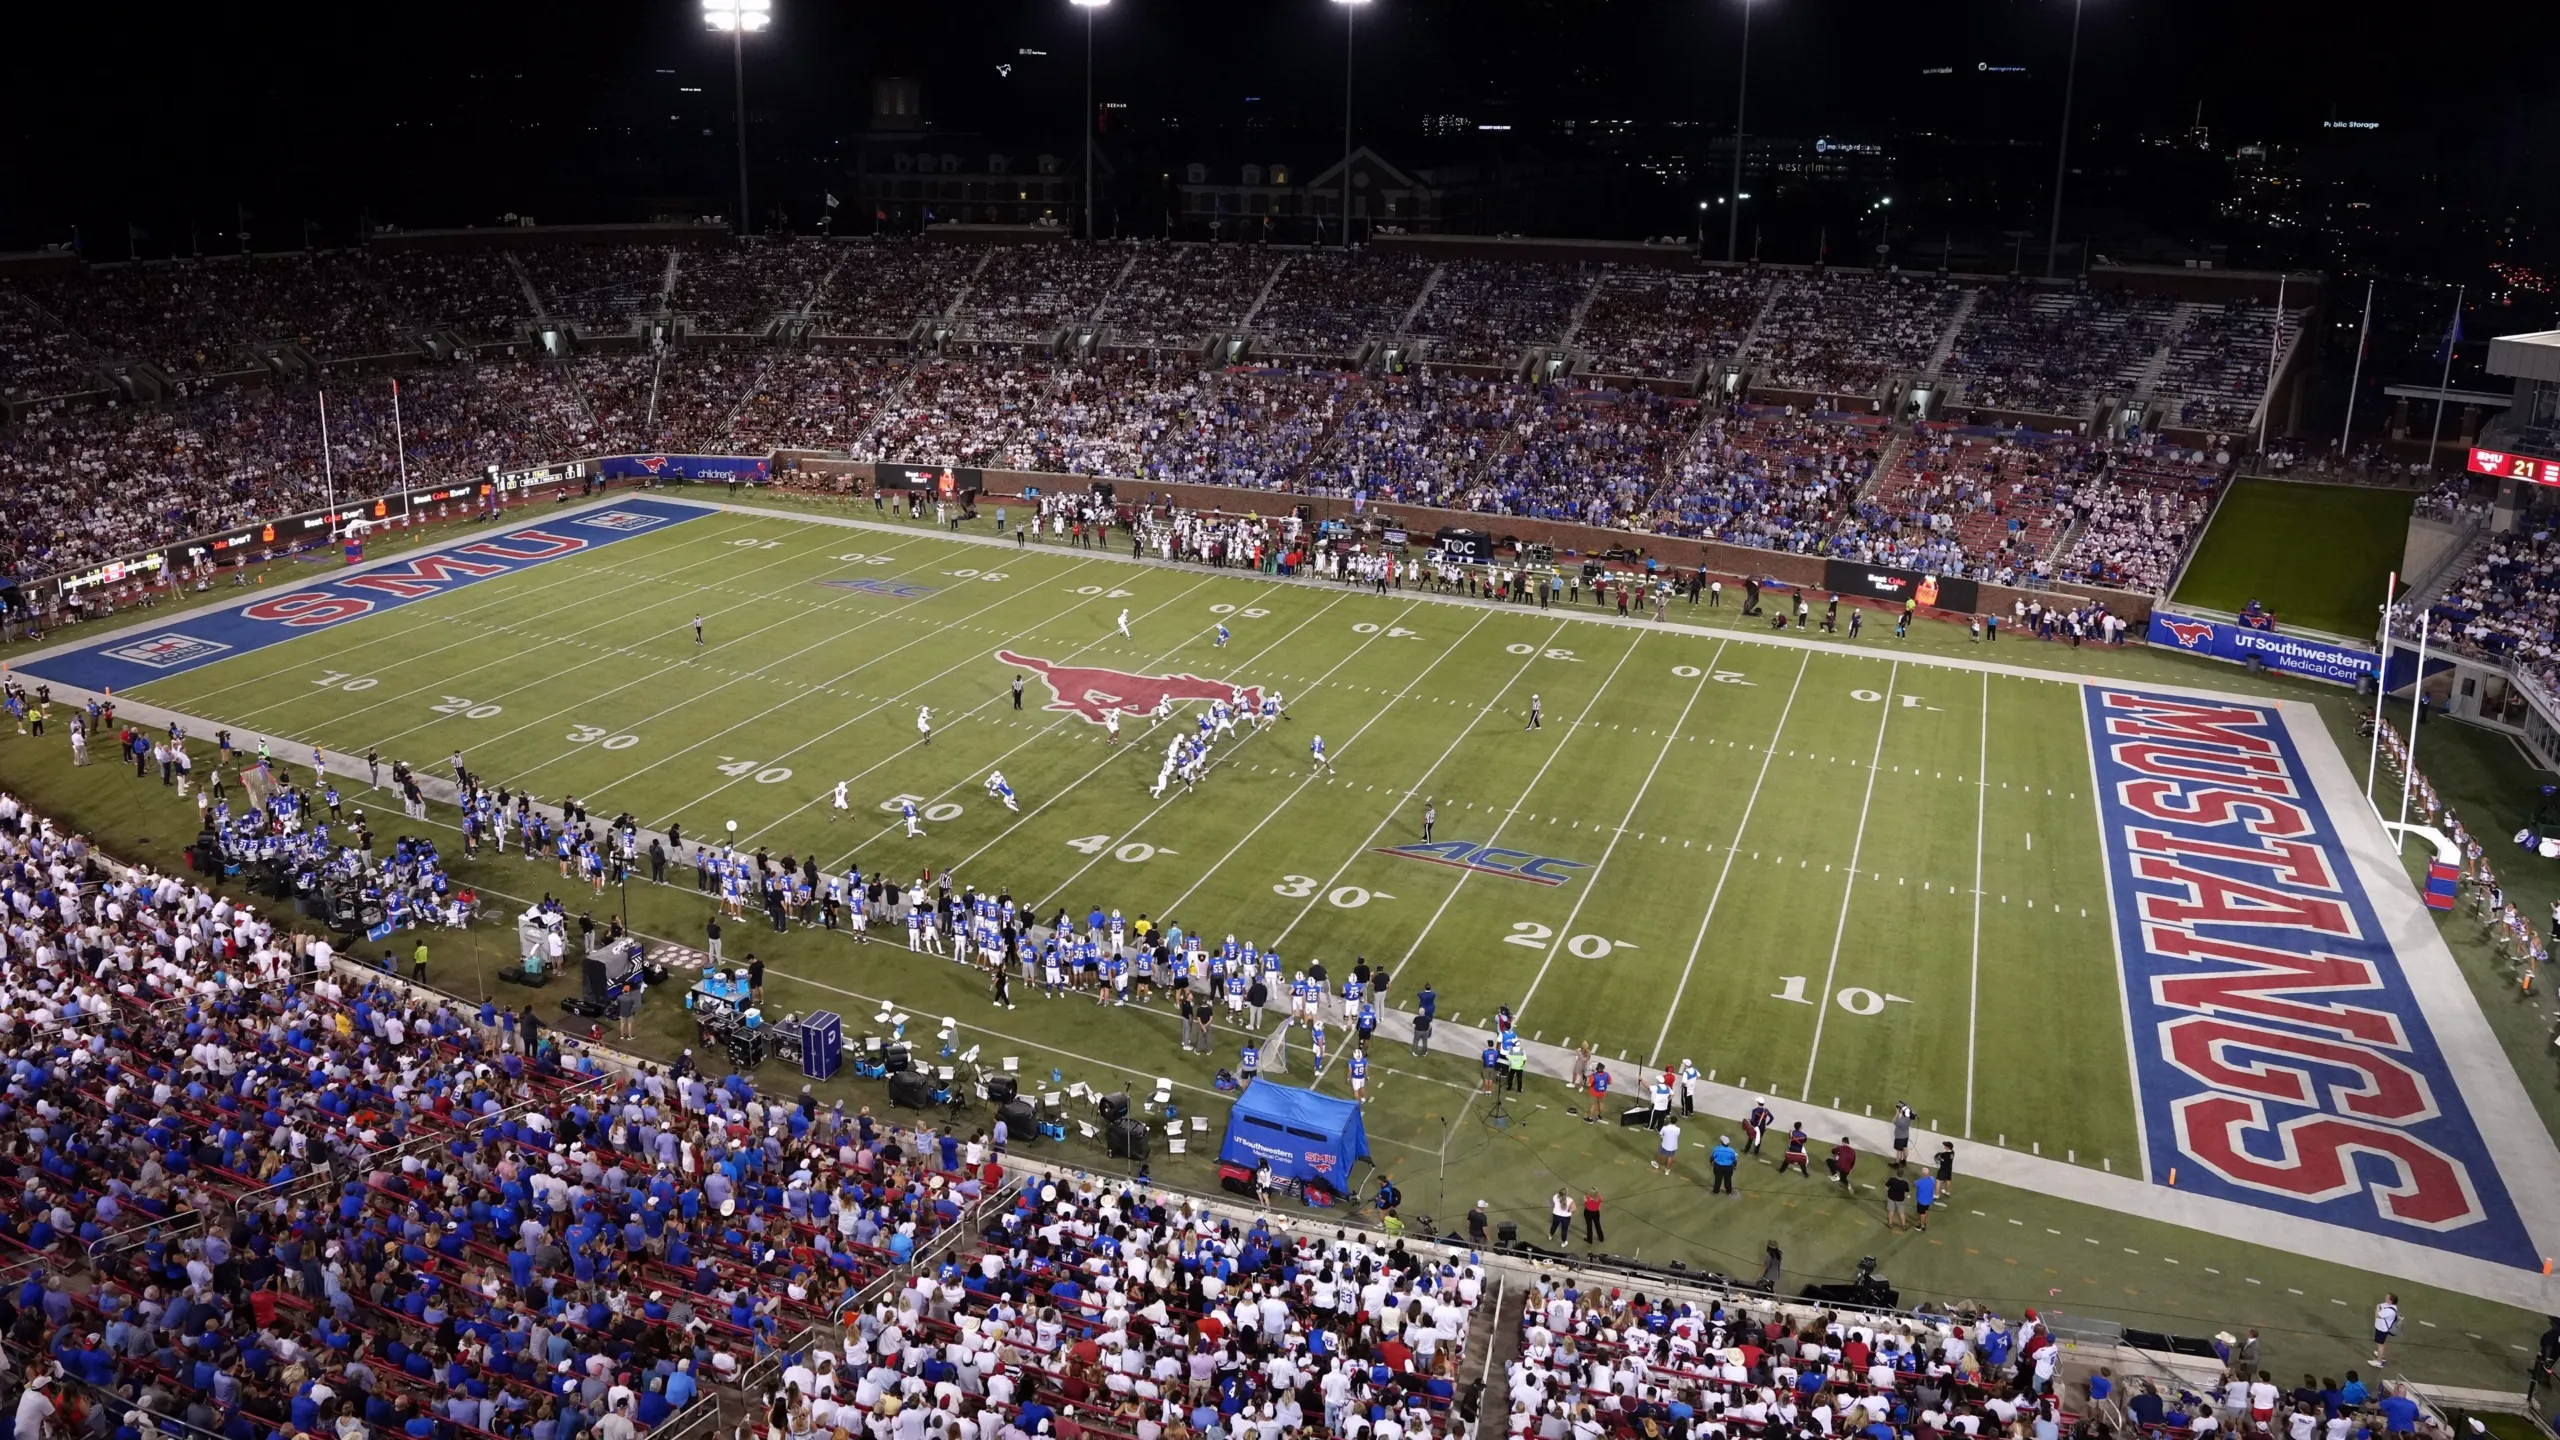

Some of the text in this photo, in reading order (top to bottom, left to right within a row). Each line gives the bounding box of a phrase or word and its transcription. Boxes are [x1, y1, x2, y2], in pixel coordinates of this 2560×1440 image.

[2348, 121, 2380, 129] Storage
[1777, 163, 1801, 172] west
[2476, 451, 2504, 463] SMU
[2513, 460, 2535, 477] 21
[413, 487, 471, 504] Best Coke Ever?
[304, 517, 324, 528] Best
[210, 541, 228, 550] oke
[228, 533, 252, 547] Ever?
[733, 538, 785, 549] 10
[840, 552, 895, 565] 20
[240, 529, 589, 627] SMU
[952, 568, 1010, 582] 30
[1867, 573, 1907, 586] Best Coke
[826, 577, 940, 598] ACC
[1075, 585, 1134, 599] 40
[1875, 582, 1898, 592] Ever?
[1209, 603, 1271, 618] 50
[1351, 622, 1416, 638] 40
[149, 645, 204, 661] FORD
[1506, 643, 1575, 661] 30
[1671, 665, 1746, 684] 20
[2279, 655, 2358, 681] Medical Cent
[311, 672, 379, 691] 10
[1850, 689, 1923, 708] 10
[430, 697, 502, 719] 20
[566, 726, 639, 750] 30
[716, 760, 793, 784] 40
[880, 793, 964, 821] 50
[1066, 834, 1155, 863] 40
[1387, 840, 1595, 884] ACC
[1272, 874, 1371, 909] 30
[1188, 943, 1197, 951] 15
[1503, 921, 1613, 960] 20
[1229, 949, 1235, 958] 2
[1245, 955, 1251, 964] 6
[1266, 960, 1275, 969] 41
[2101, 690, 2488, 1233] MUSTANGS
[1349, 990, 1359, 999] 75
[1770, 975, 1886, 1016] 10
[1364, 1018, 1370, 1026] 4
[1243, 1055, 1255, 1065] 43
[1353, 1066, 1365, 1076] 49
[1253, 1149, 1293, 1164] Medical Center
[1305, 1151, 1336, 1165] SMU
[1102, 1245, 1115, 1257] 14
[1182, 1250, 1196, 1260] 44
[1355, 1250, 1361, 1260] 2
[1374, 1261, 1381, 1271] 2
